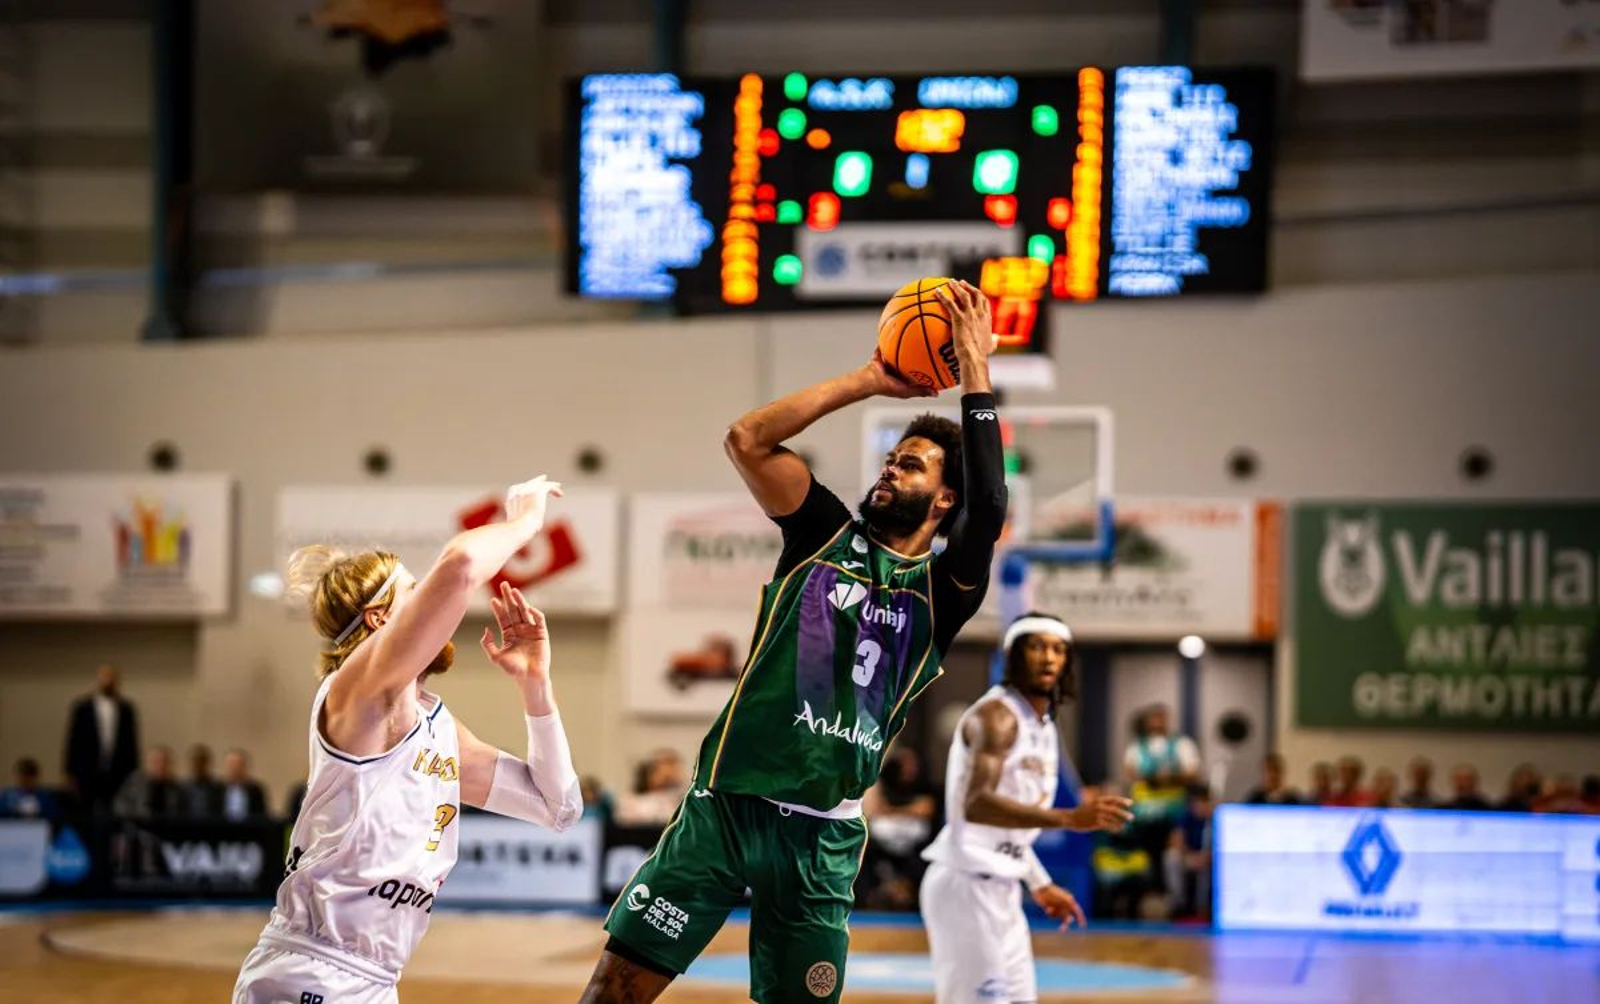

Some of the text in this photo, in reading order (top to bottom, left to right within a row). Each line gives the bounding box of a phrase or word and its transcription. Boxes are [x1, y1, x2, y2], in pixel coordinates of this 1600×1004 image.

[1392, 529, 1600, 607] Vailla
[852, 639, 882, 687] 3
[648, 904, 684, 933] DEL SOL
[654, 896, 689, 924] COSTA
